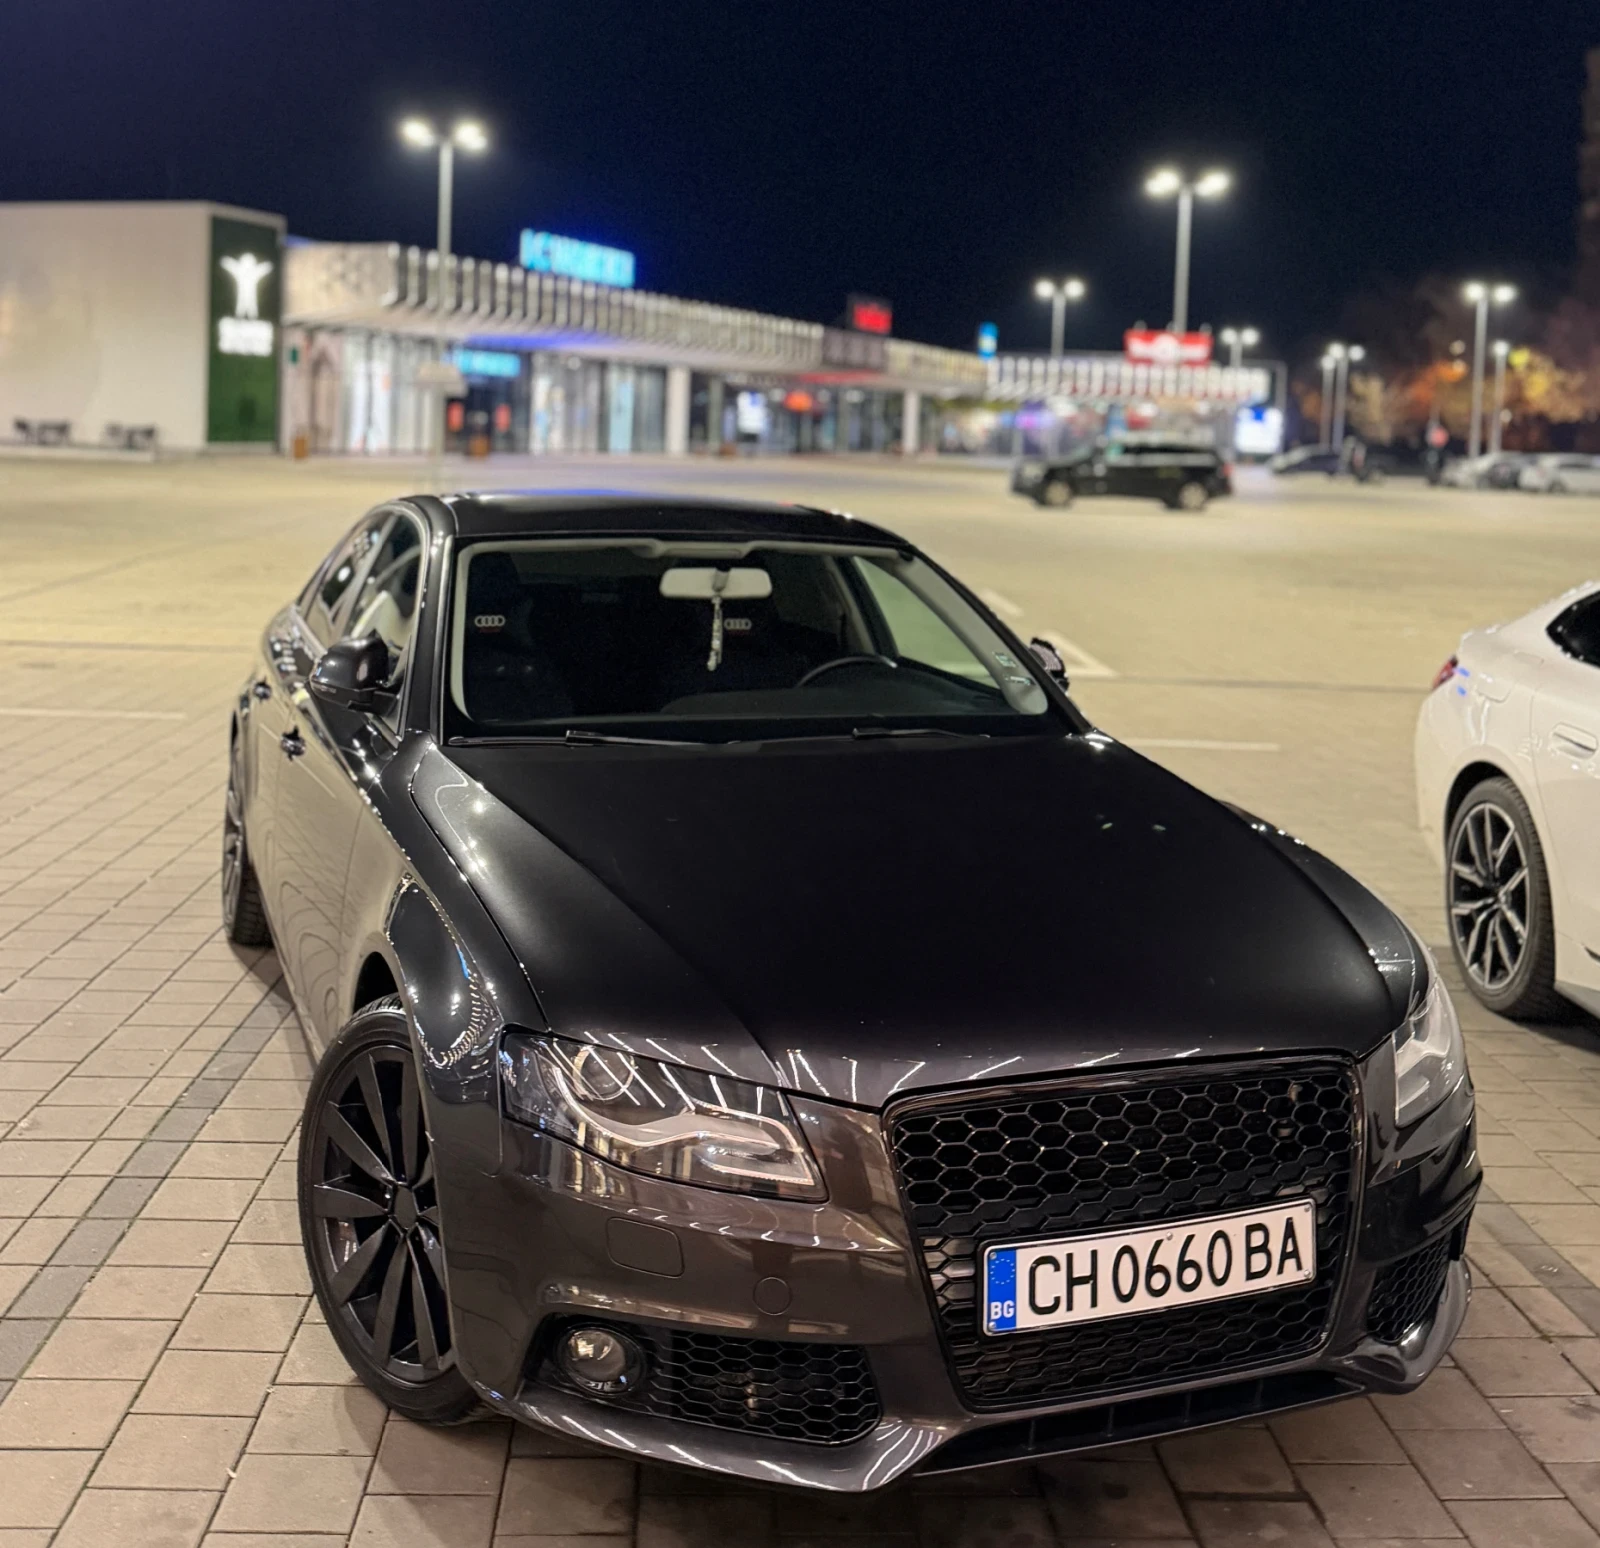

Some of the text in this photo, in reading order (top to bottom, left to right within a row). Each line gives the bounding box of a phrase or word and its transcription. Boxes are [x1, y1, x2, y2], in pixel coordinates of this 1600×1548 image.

[1028, 1216, 1303, 1315] CH 0660 BA
[990, 1300, 1015, 1320] BG
